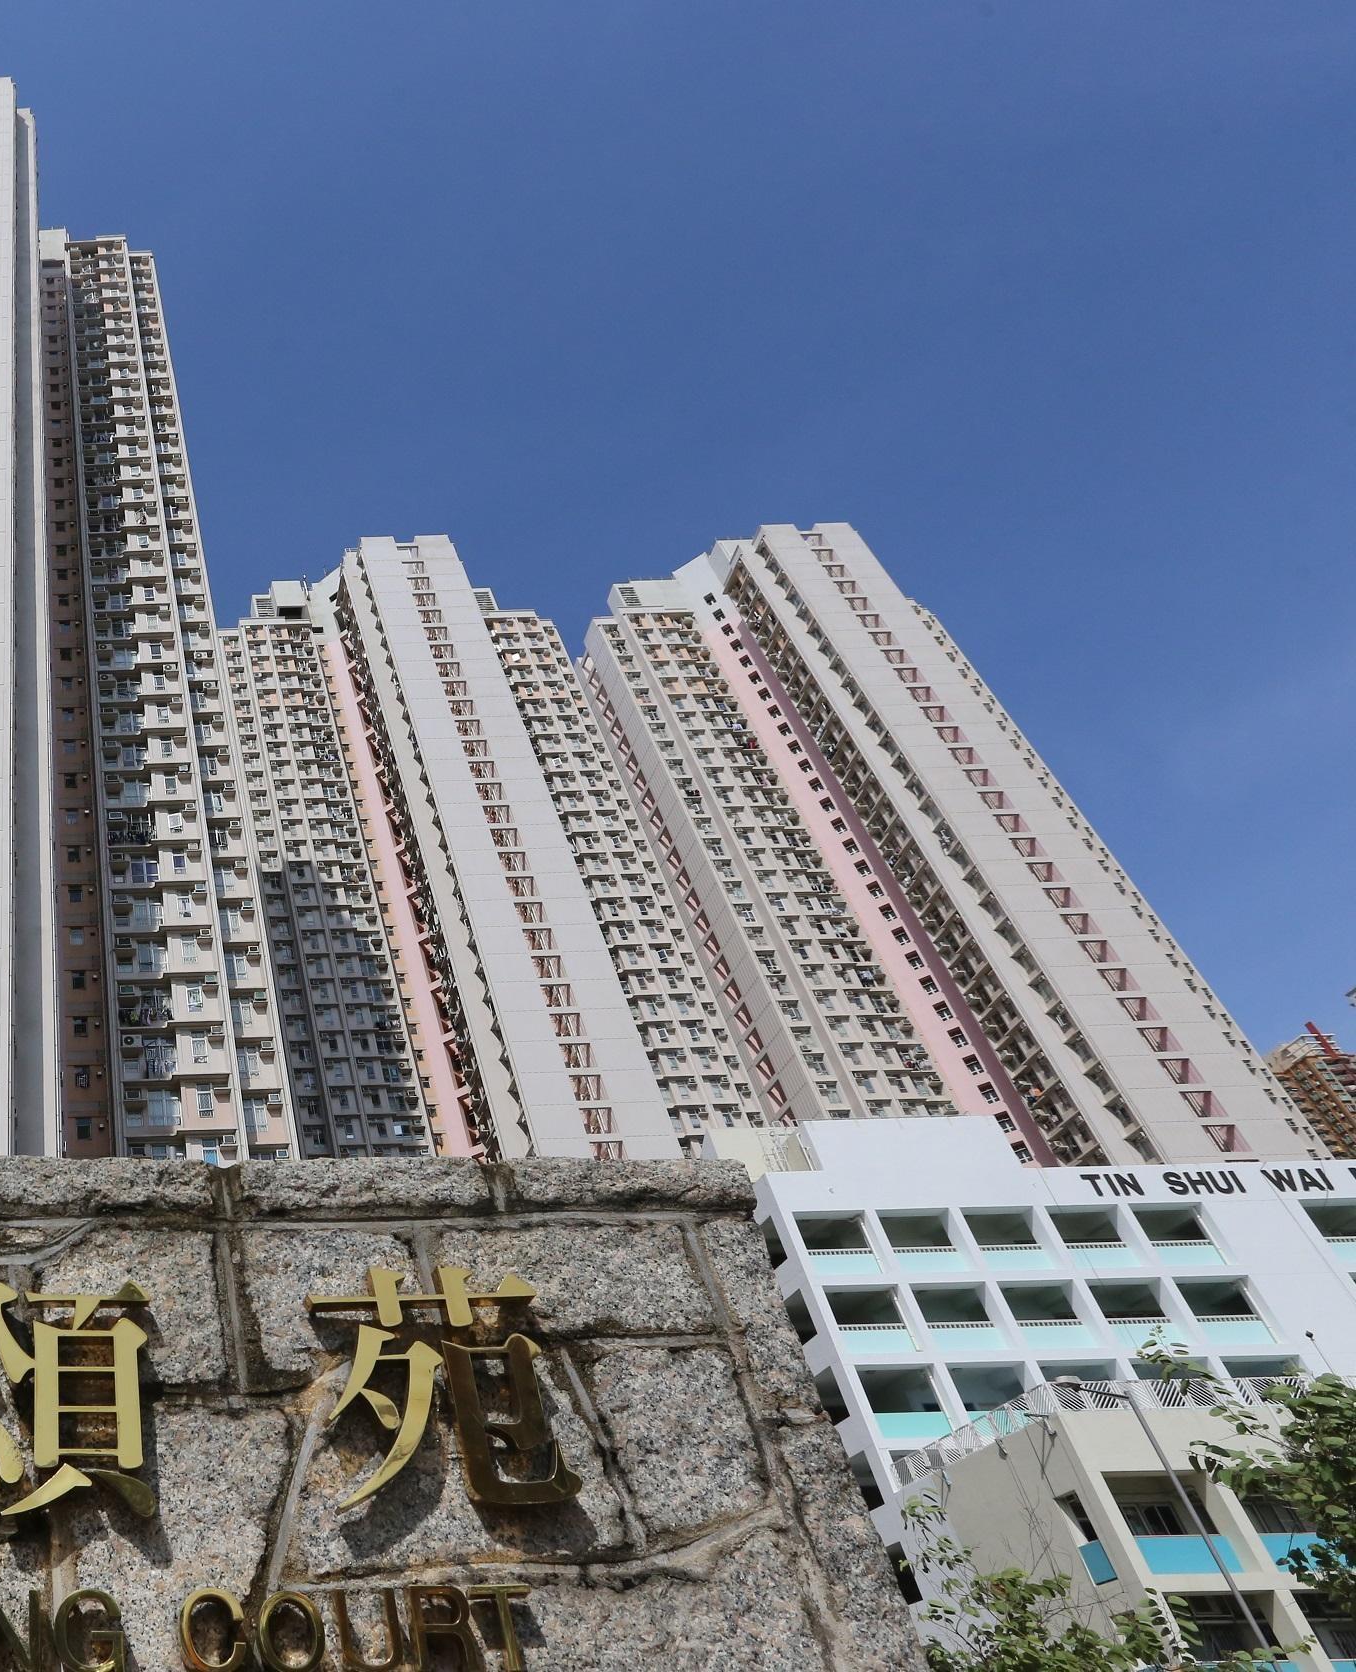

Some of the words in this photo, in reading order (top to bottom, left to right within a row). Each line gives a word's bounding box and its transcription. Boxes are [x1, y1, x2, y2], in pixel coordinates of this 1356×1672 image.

[1080, 1173, 1145, 1197] TIN
[1162, 1171, 1247, 1195] SHUI
[1260, 1168, 1335, 1192] WAI
[178, 1583, 532, 1672] COURT
